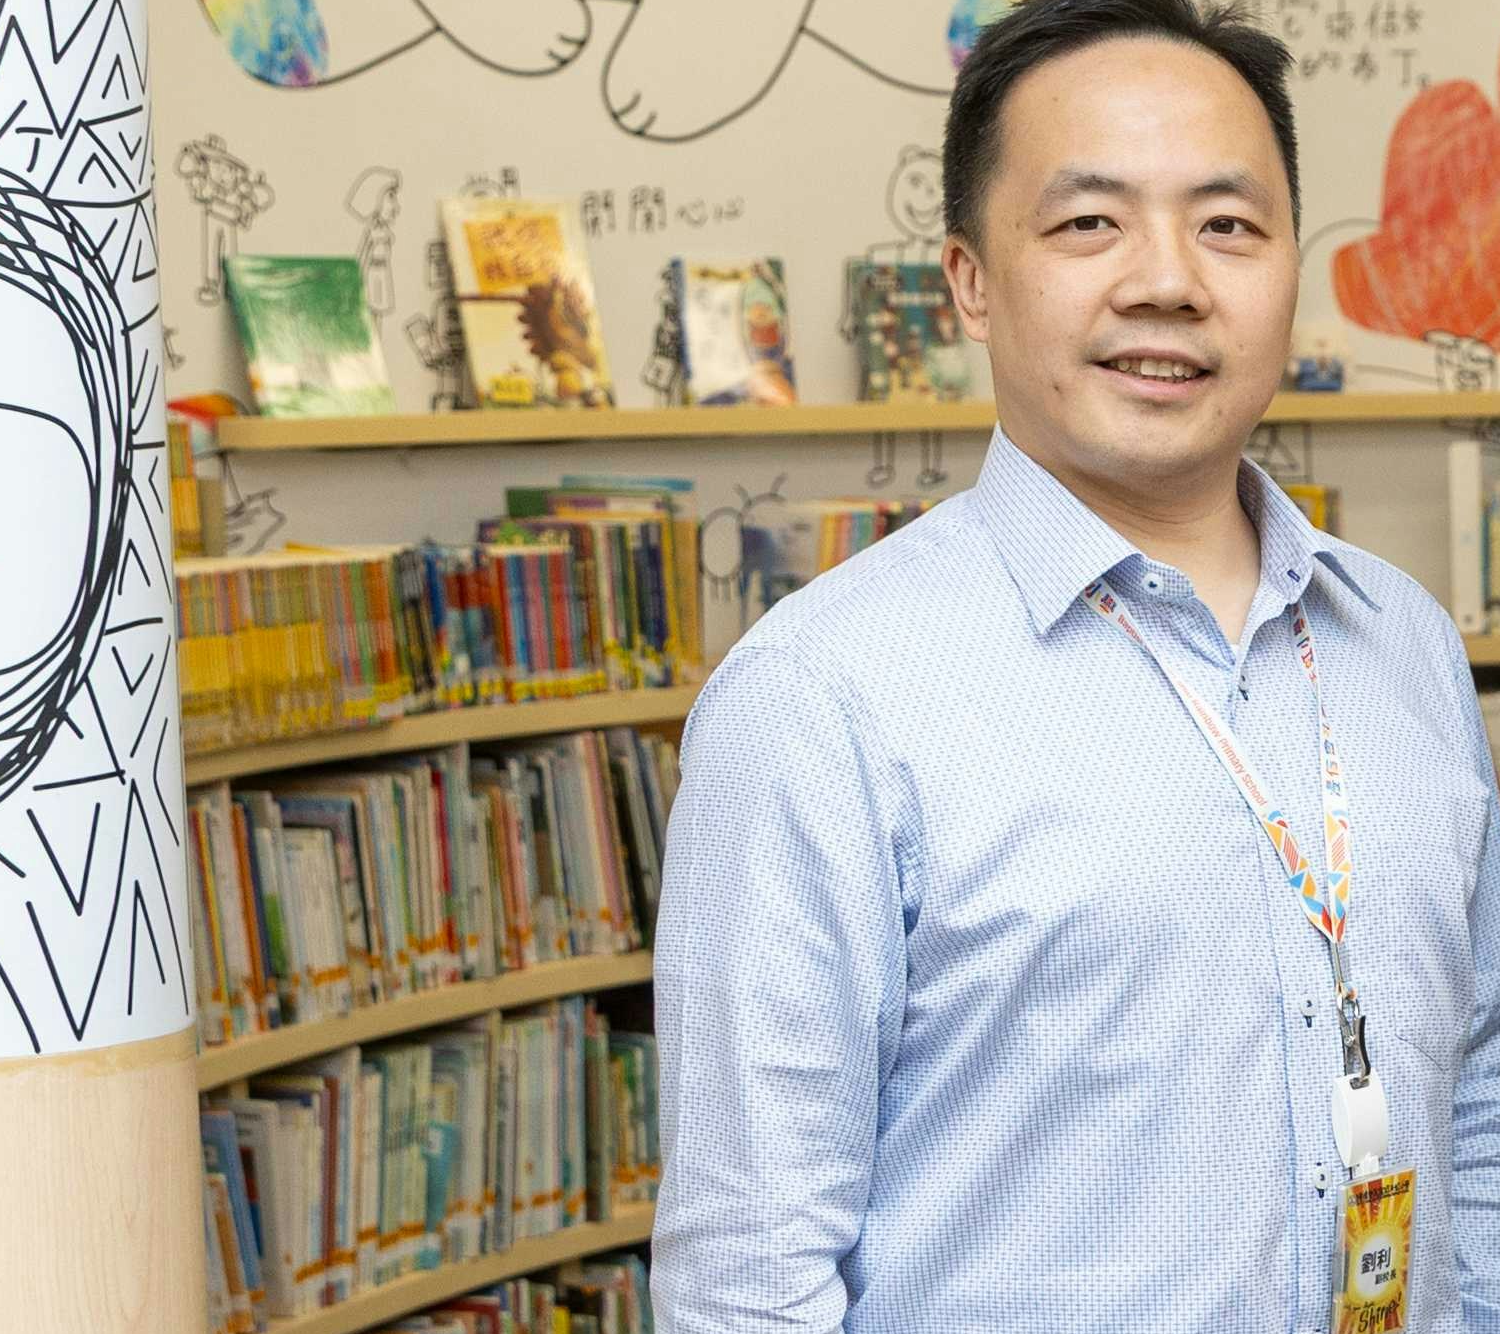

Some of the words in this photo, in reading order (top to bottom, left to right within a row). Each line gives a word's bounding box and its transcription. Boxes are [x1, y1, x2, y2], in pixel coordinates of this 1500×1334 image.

[1190, 697, 1222, 740] Rainbow
[1217, 736, 1246, 775] Primary
[1240, 772, 1270, 808] School
